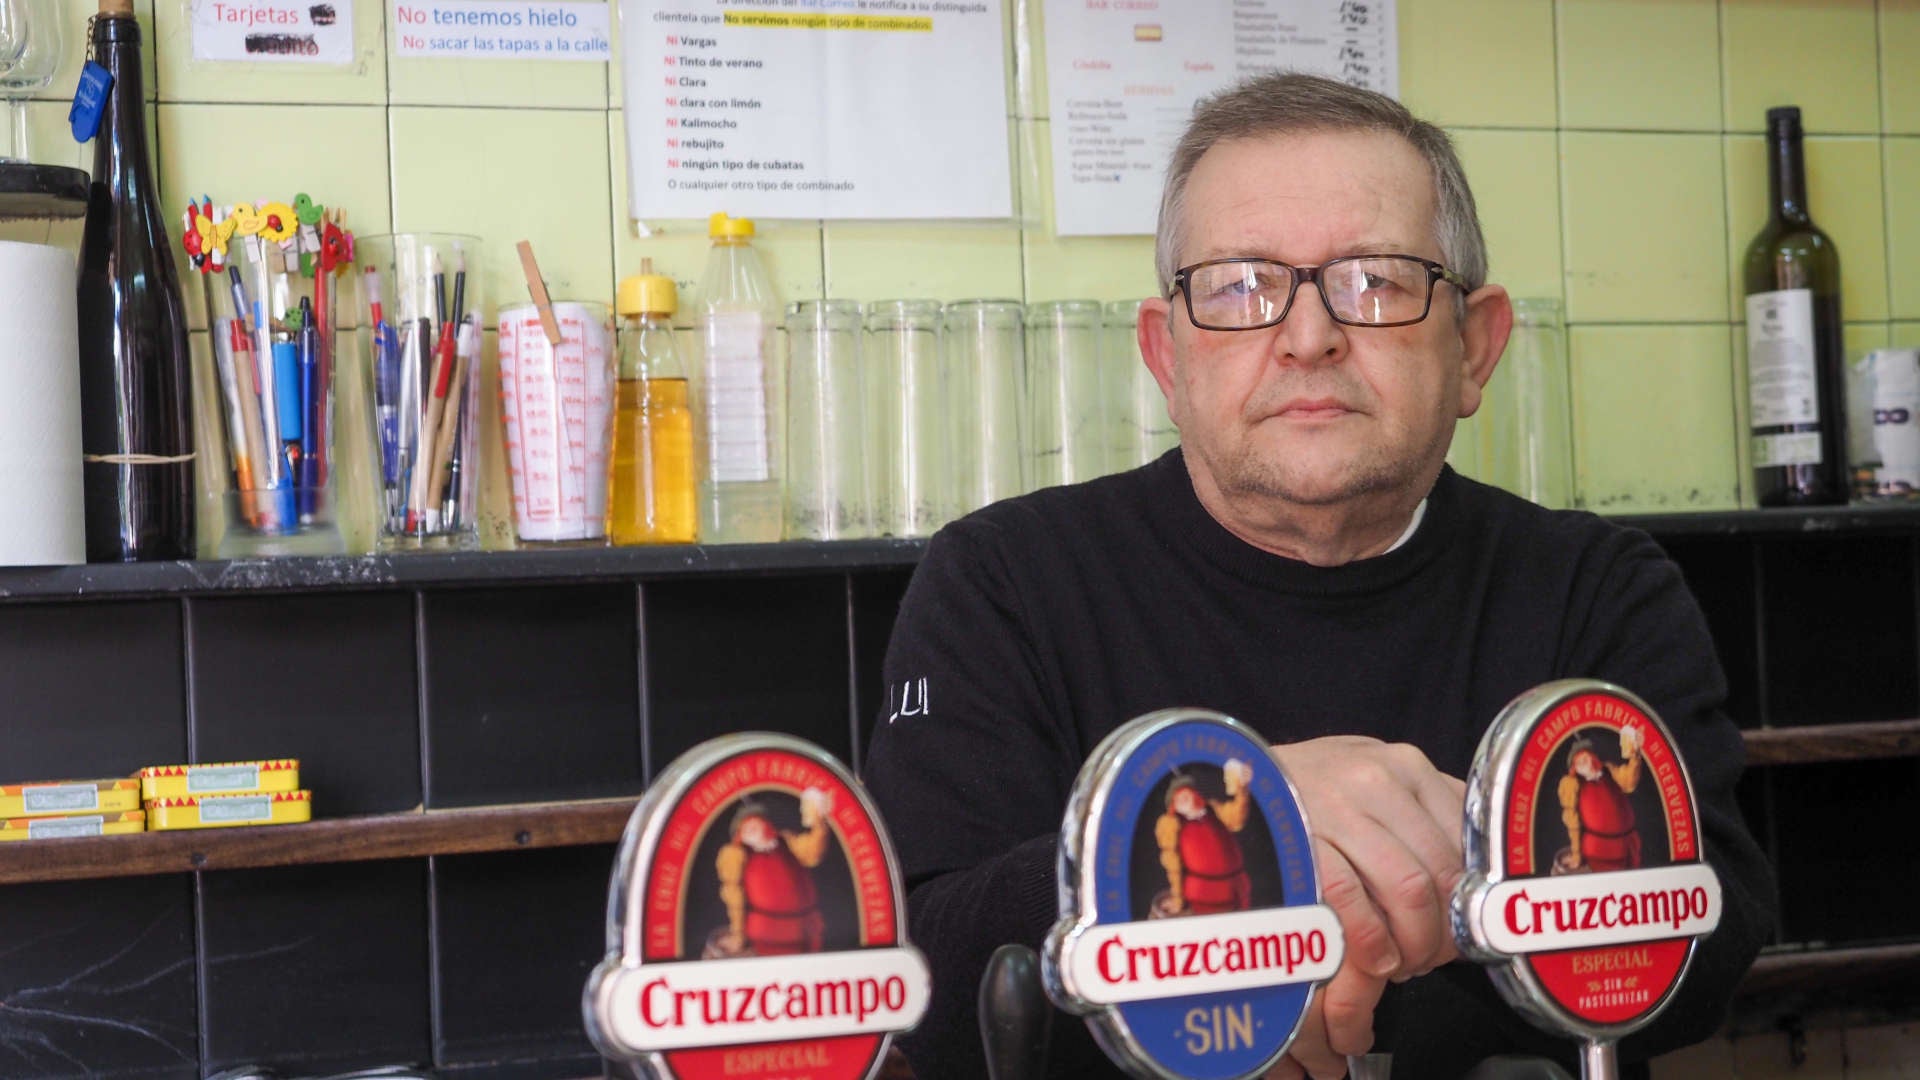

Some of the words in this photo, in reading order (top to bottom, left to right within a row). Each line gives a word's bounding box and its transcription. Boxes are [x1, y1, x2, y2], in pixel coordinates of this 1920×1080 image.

[213, 3, 299, 26] Tarjetas
[398, 7, 426, 24] No
[433, 9, 522, 26] tenemos
[528, 8, 577, 27] hielo
[869, 0, 908, 12] notifica
[920, 4, 931, 12] su
[932, 3, 988, 16] distinguida
[653, 11, 698, 23] clientela
[701, 15, 721, 26] que
[724, 13, 740, 25] No
[742, 15, 790, 27] servimos
[792, 16, 827, 30] ningún
[830, 18, 850, 30] tipo
[852, 18, 865, 28] de
[403, 36, 424, 49] No
[429, 38, 468, 50] sacar
[474, 36, 494, 50] las
[499, 38, 540, 53] tapas
[545, 40, 553, 51] a
[557, 37, 570, 51] la
[574, 37, 608, 52] calle
[667, 36, 678, 45] Ni
[681, 37, 717, 48] Vargas
[664, 56, 676, 66] Ni
[679, 57, 706, 67] Tinto
[709, 58, 723, 68] de
[726, 60, 763, 69] verano
[665, 77, 677, 87] Ni
[679, 77, 706, 88] Clara
[666, 98, 677, 107] Ni
[680, 98, 705, 109] clara
[709, 101, 728, 109] con
[731, 99, 761, 110] limón
[667, 118, 678, 127] Ni
[681, 119, 737, 129] Kalimocho
[667, 139, 678, 148] Ni
[682, 139, 724, 151] rebujito
[668, 159, 679, 168] Ni
[682, 159, 719, 171] ningún
[722, 160, 744, 172] tipo
[747, 160, 760, 170] de
[763, 161, 804, 171] cubatas
[668, 180, 677, 189] O
[680, 180, 727, 193] cualquier
[731, 182, 754, 191] otro
[757, 181, 778, 193] tipo
[781, 181, 793, 191] de
[796, 182, 855, 192] combinado
[1536, 701, 1581, 751] CAMPO
[1521, 756, 1538, 782] DEL
[1514, 791, 1530, 834] CRUZ
[1658, 762, 1690, 854] CERVEZAS
[1513, 844, 1526, 866] LA
[1503, 886, 1708, 935] Cruzcampo
[1096, 928, 1327, 985] Cruzcampo
[1572, 947, 1653, 975] ESPECIAL
[1604, 977, 1621, 992] SIN
[638, 975, 907, 1029] Cruzcampo
[724, 1043, 831, 1076] ESPECIAL
